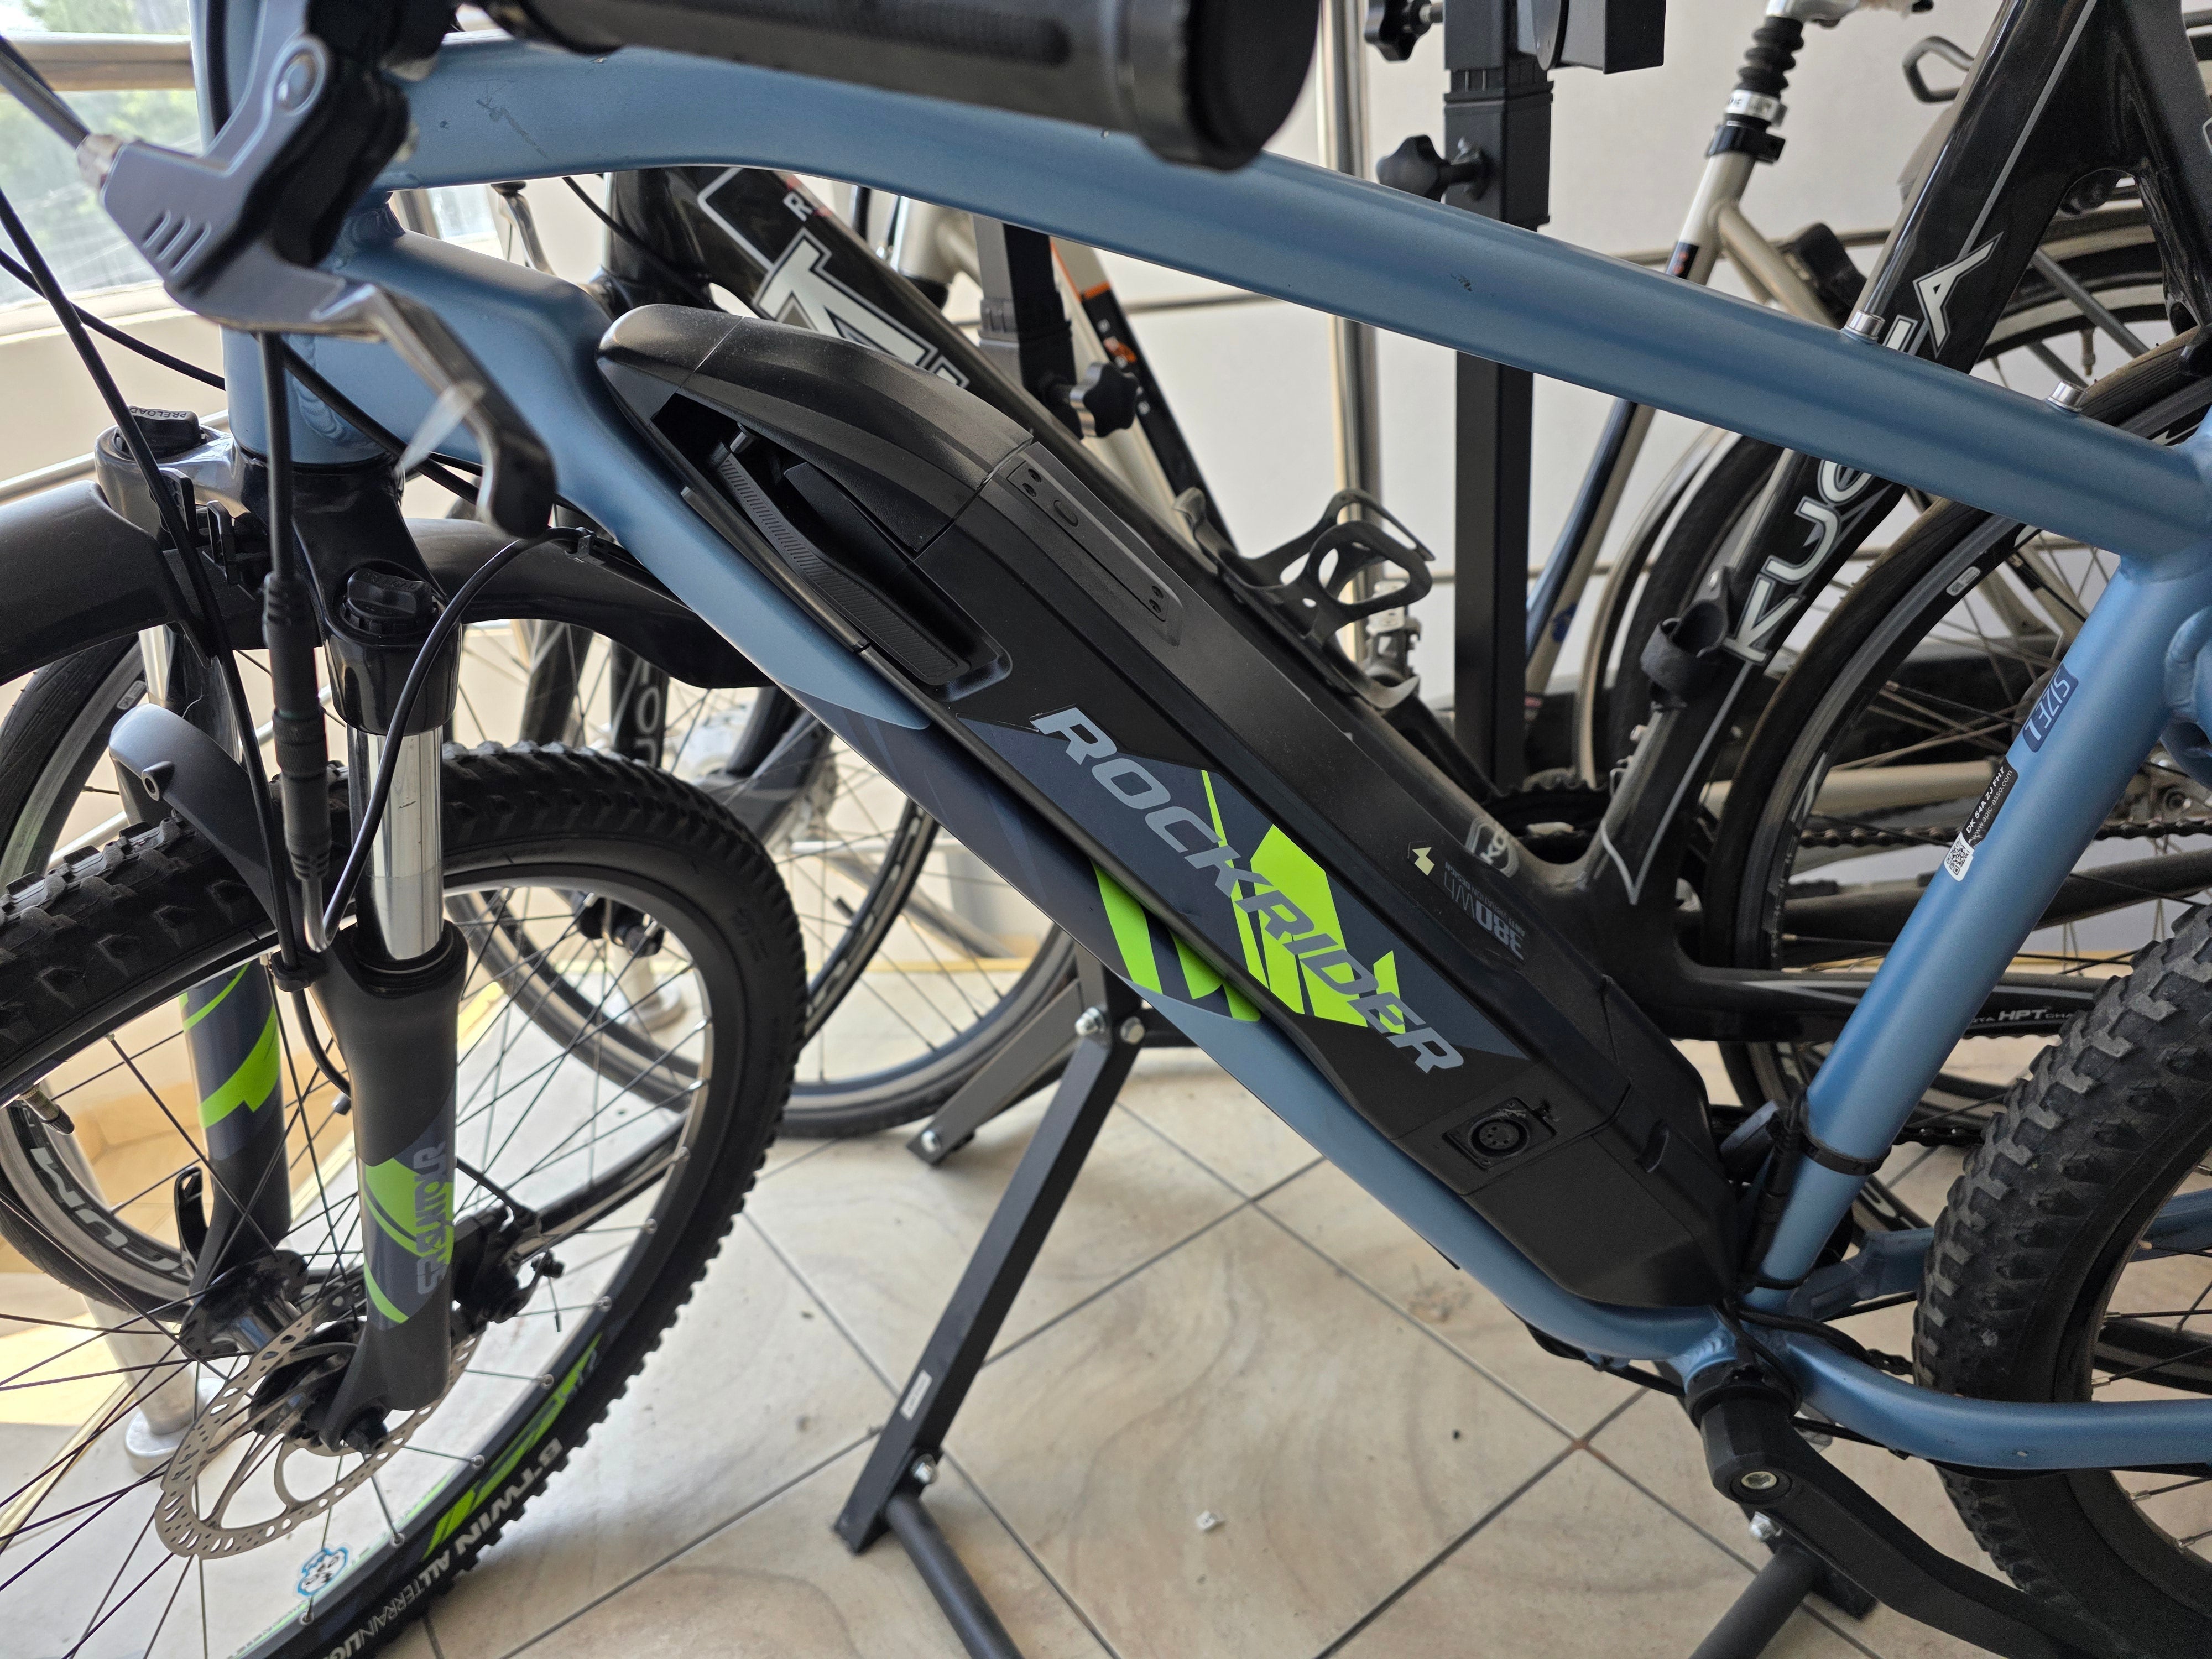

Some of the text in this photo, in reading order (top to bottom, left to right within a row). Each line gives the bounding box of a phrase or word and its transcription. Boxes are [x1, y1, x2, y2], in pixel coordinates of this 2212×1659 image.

[129, 406, 187, 419] PRELOAD
[2025, 669, 2070, 741] SIZE L
[1966, 766, 2005, 834] DK 54A ZJ FH7
[1971, 769, 2013, 840] www.apic-asso.com
[1029, 706, 1464, 1074] ROCKRIDER
[1444, 861, 1472, 891] DESIGN
[1997, 1008, 2047, 1021] HPT
[454, 1437, 564, 1556] B'TWIN
